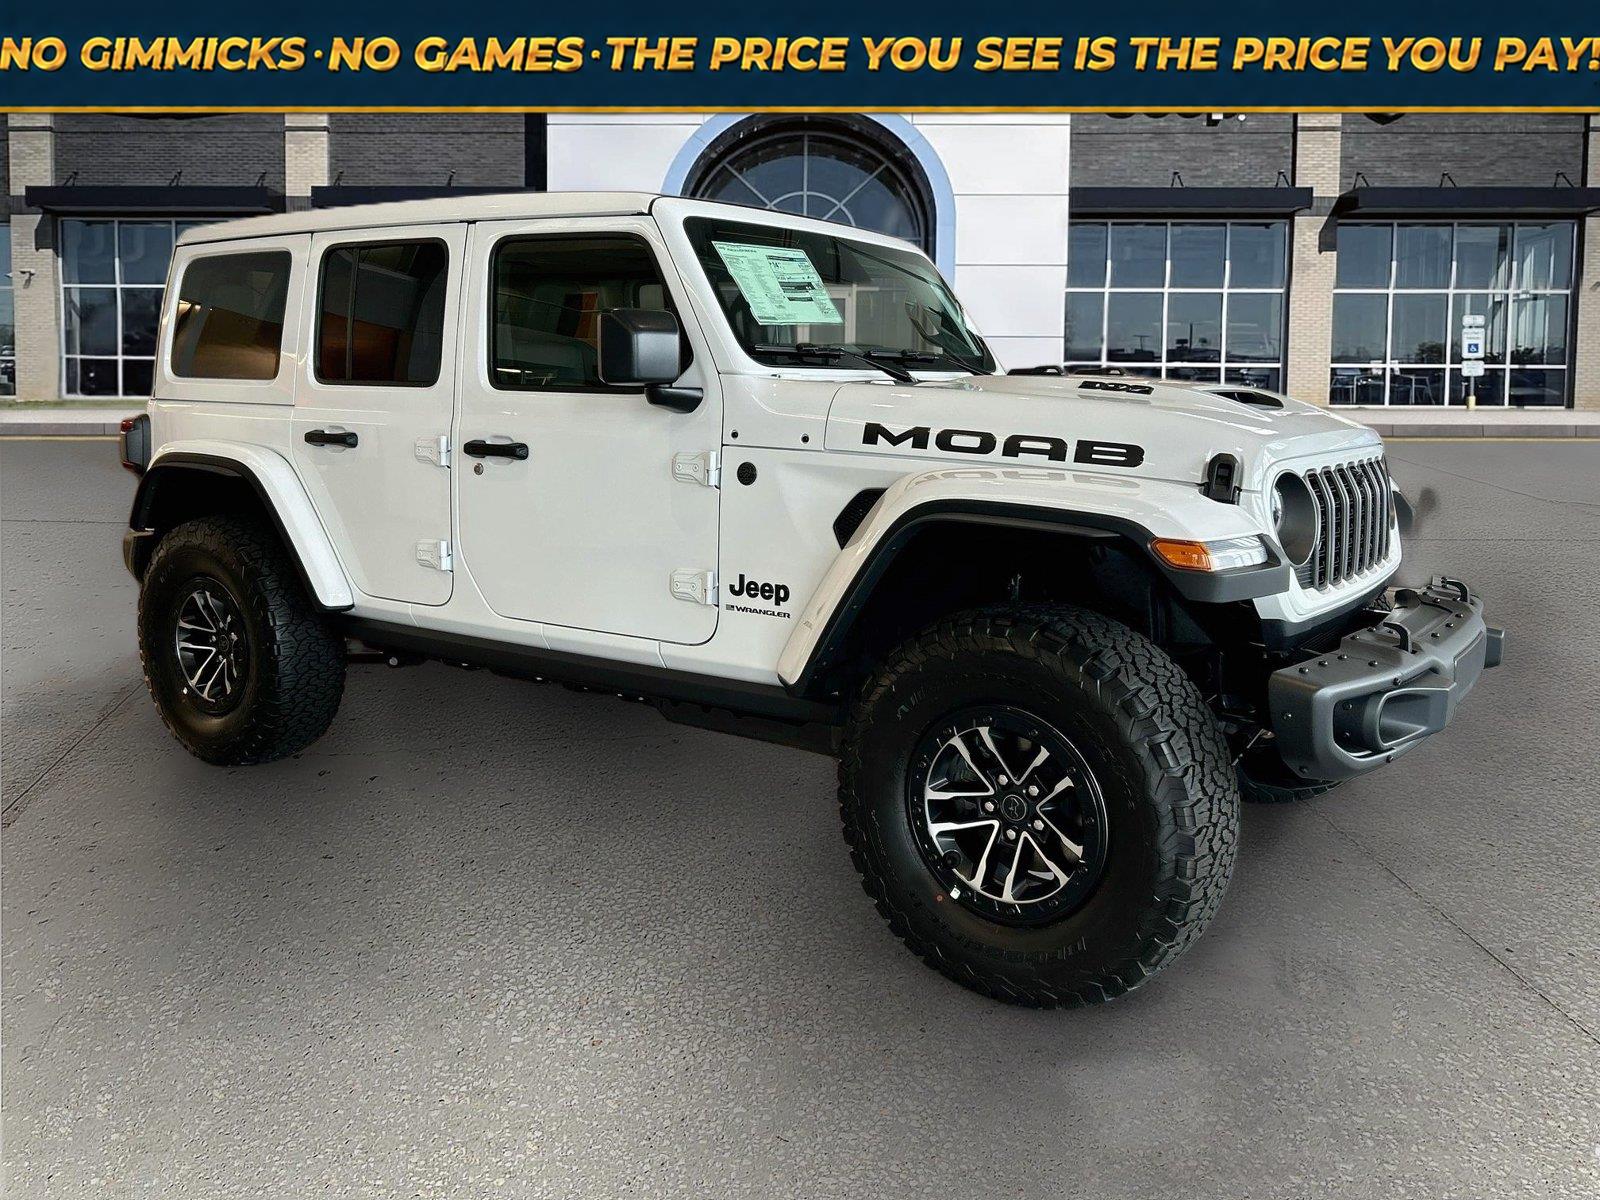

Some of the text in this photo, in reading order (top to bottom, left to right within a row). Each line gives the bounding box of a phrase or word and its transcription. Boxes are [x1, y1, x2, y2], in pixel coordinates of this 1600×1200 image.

[862, 421, 1146, 468] MOAB
[729, 573, 790, 607] Jeep
[735, 605, 791, 619] WRANGLER
